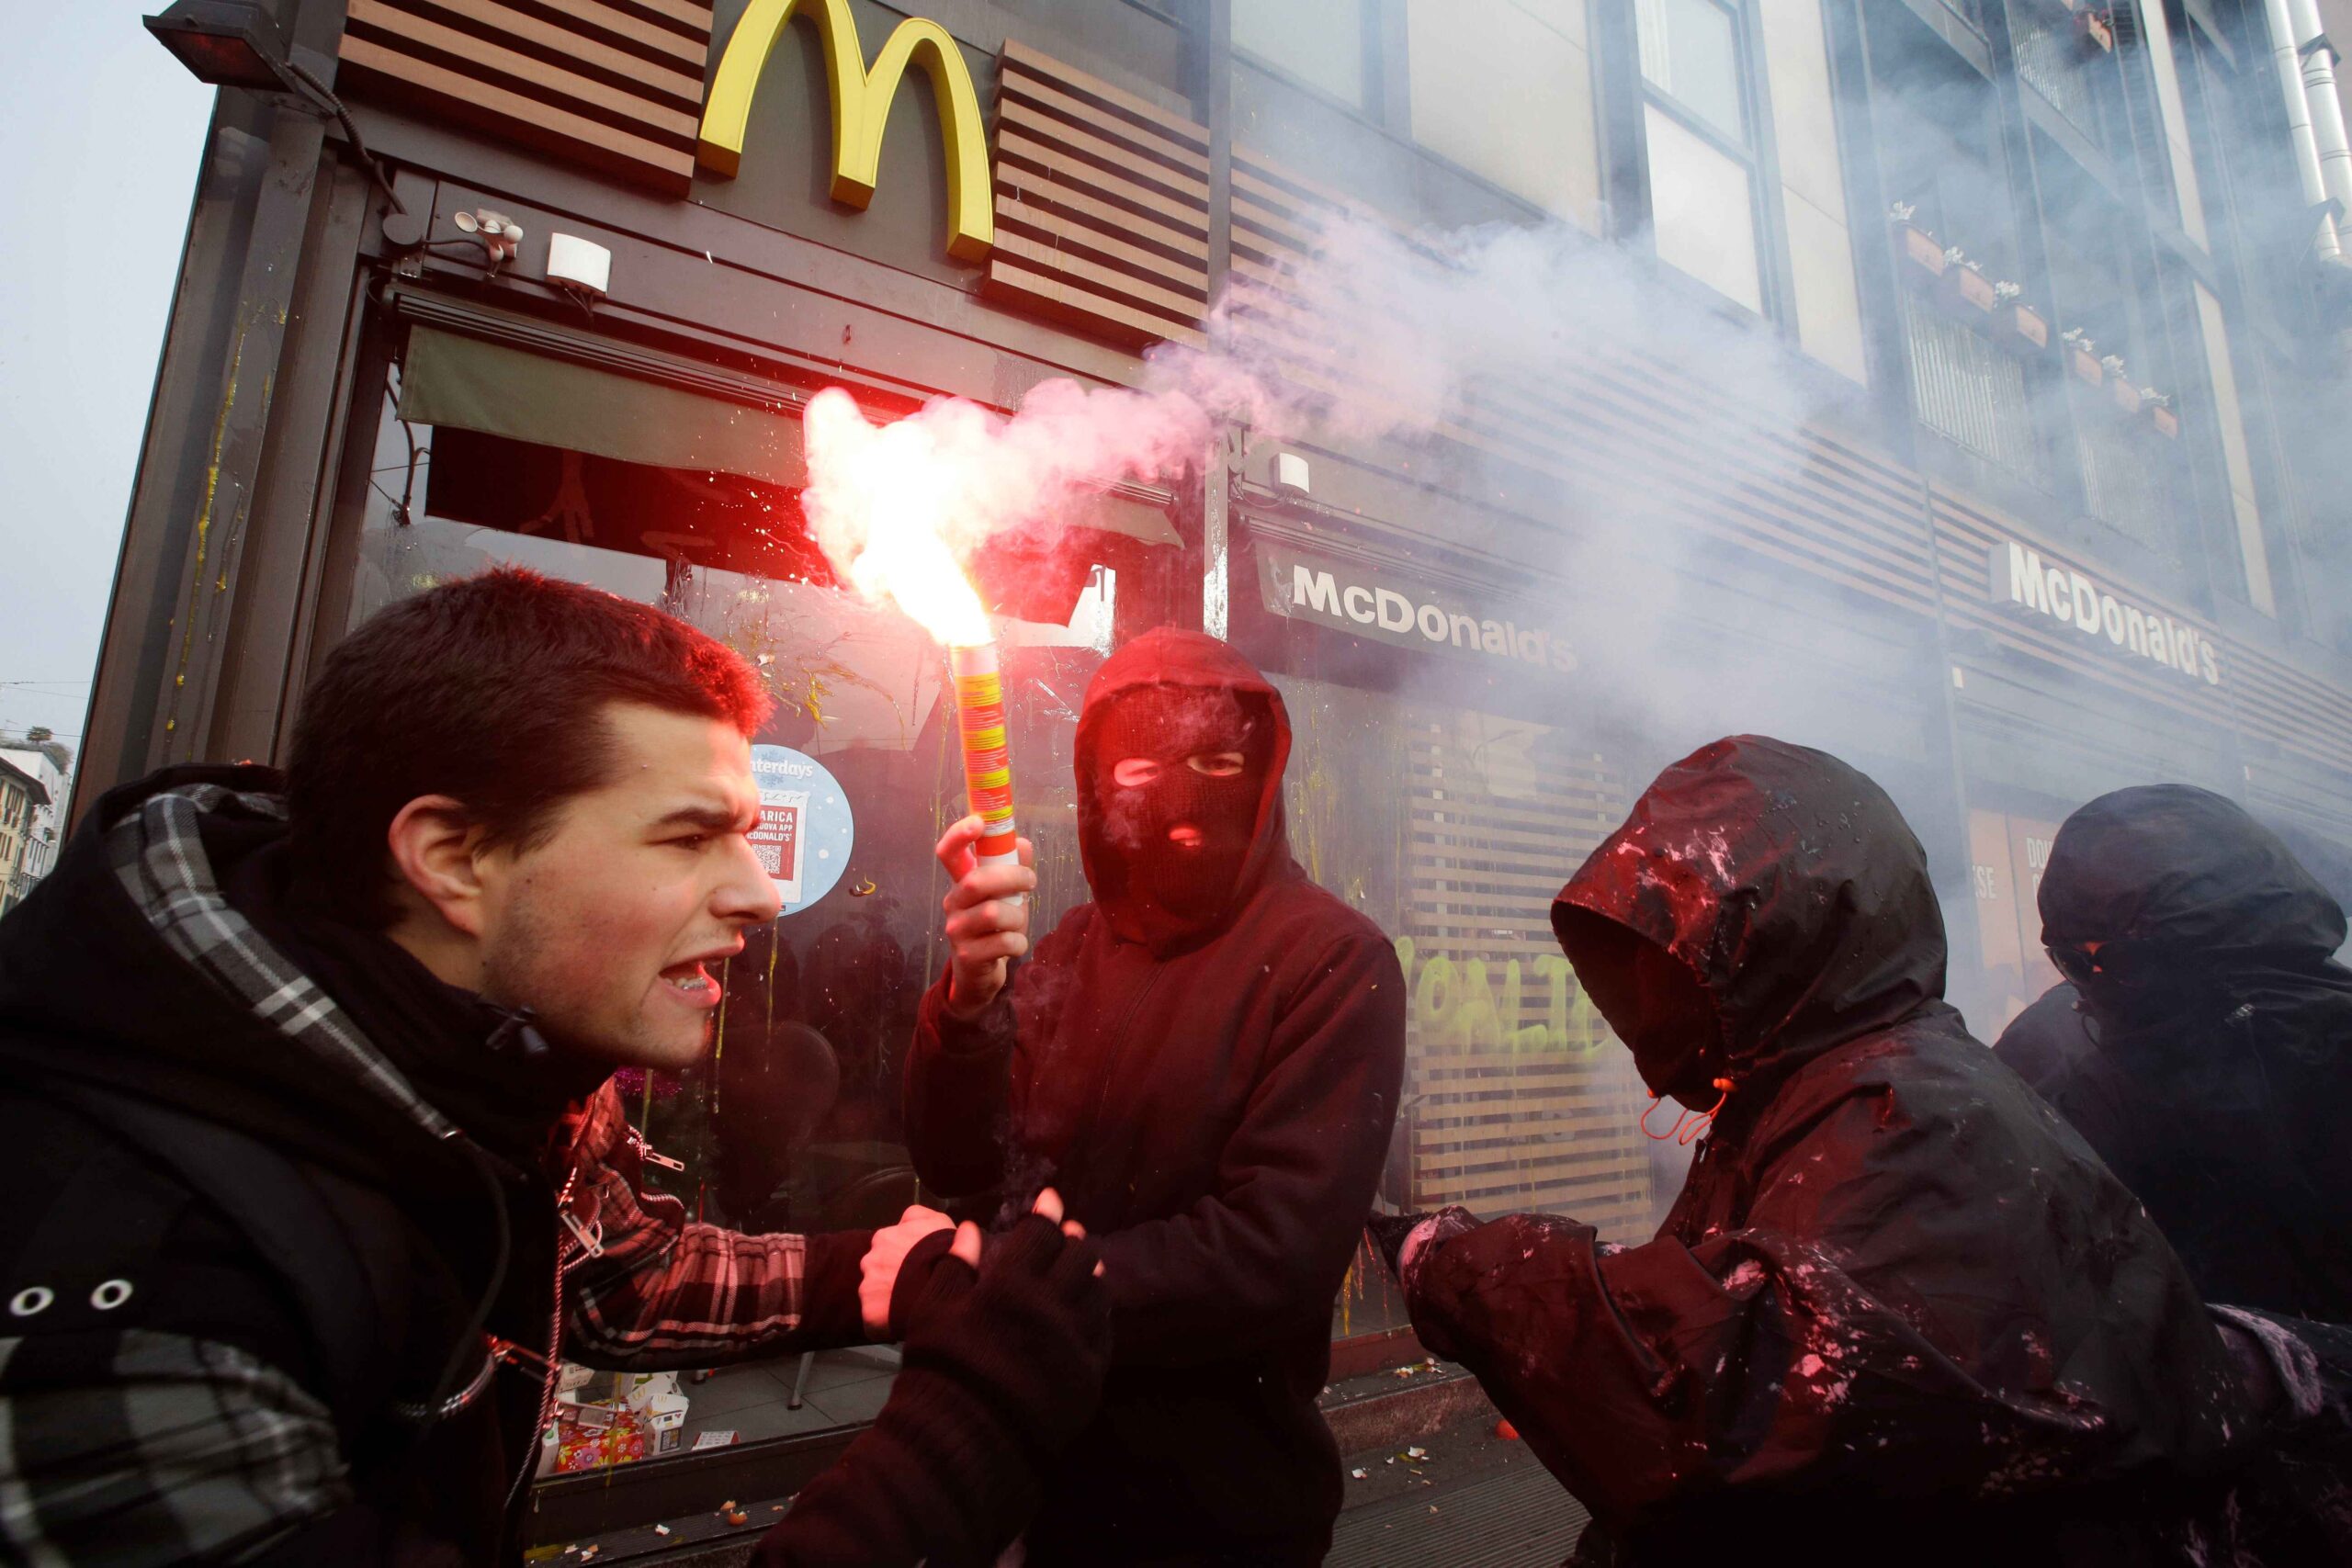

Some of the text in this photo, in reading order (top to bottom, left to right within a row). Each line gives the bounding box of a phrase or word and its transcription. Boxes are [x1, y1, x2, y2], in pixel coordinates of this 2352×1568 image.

[697, 0, 994, 265] M
[1292, 563, 1579, 674] McDonald's
[2008, 541, 2219, 685] McDonald's
[750, 759, 814, 779] nterdays
[757, 822, 793, 832] UOVA APP
[760, 810, 793, 823] ARICA
[1972, 864, 1996, 899] SE
